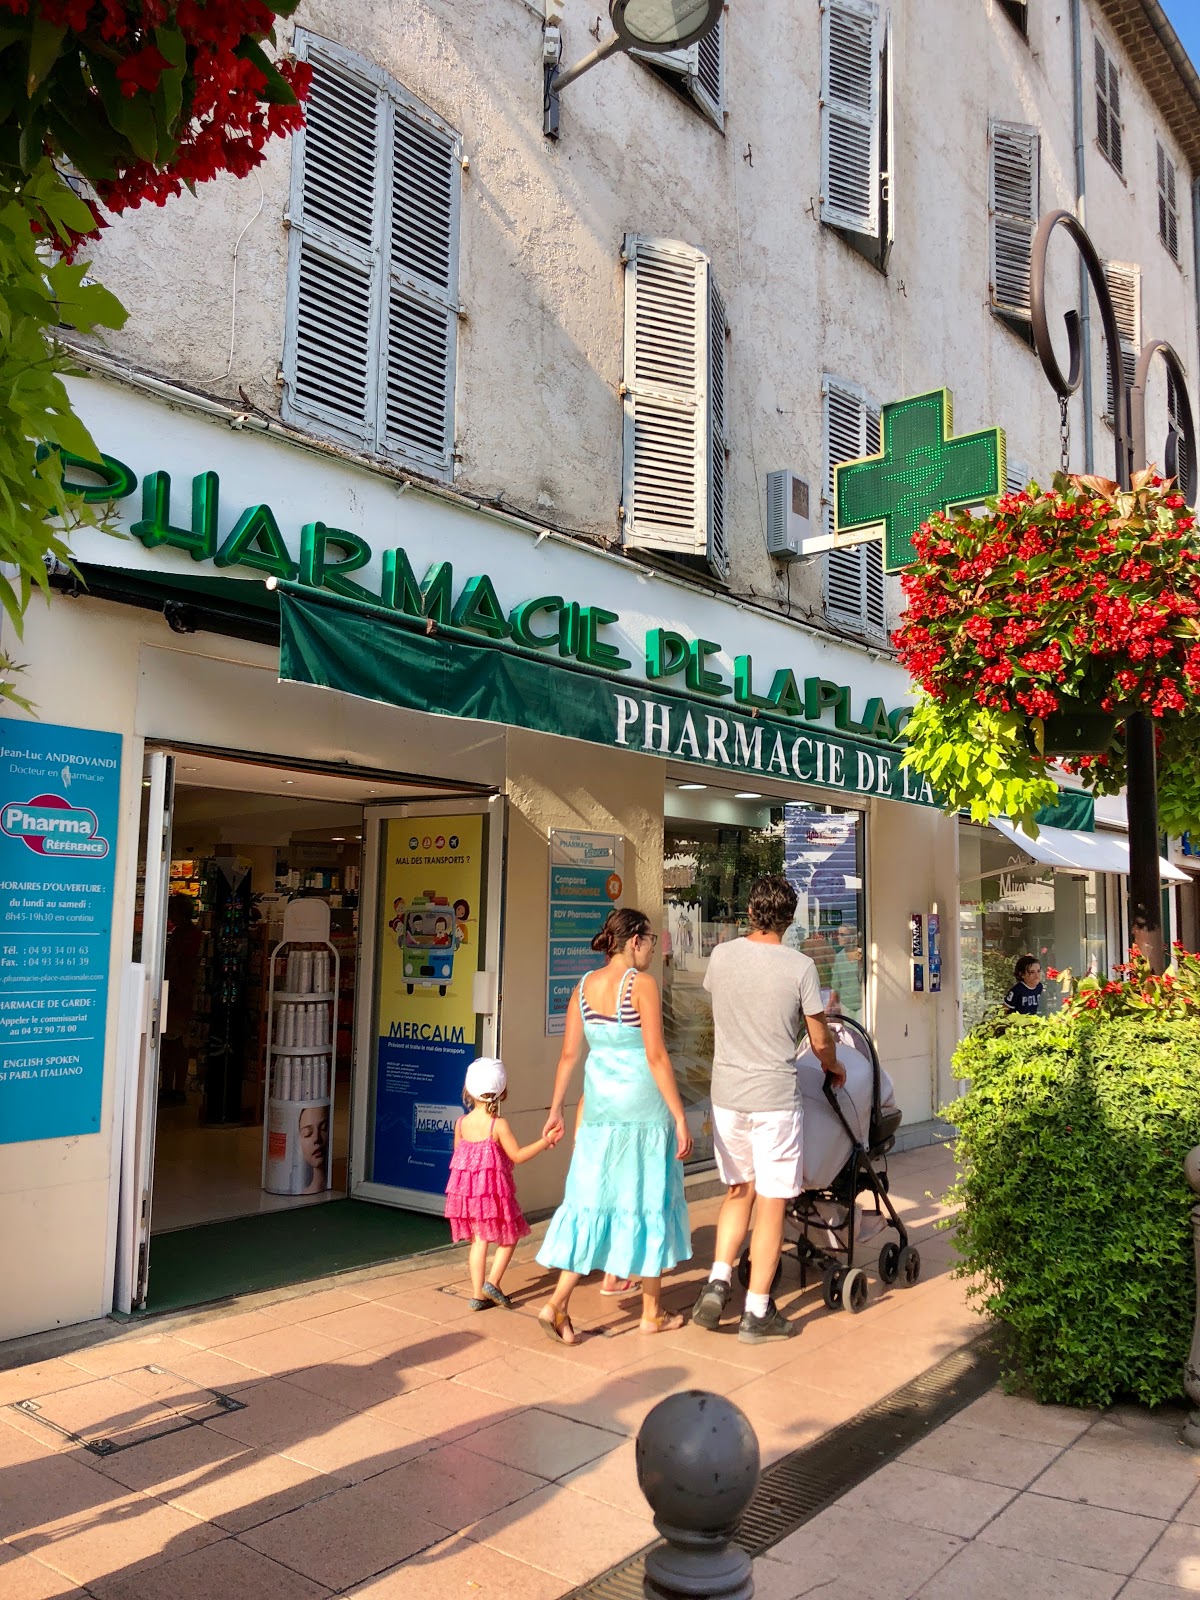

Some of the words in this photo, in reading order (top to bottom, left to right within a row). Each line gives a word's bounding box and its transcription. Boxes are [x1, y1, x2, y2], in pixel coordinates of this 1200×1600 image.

[35, 441, 632, 670] PHARMACIE
[645, 627, 733, 696] DE
[734, 654, 805, 716] LA
[613, 693, 845, 788] PHARMACIE
[855, 750, 893, 795] DE
[901, 764, 935, 803] LA
[0, 746, 43, 761] Jean-Luc
[45, 752, 117, 769] ANDROVANDI
[9, 764, 46, 776] Docteur
[47, 770, 58, 778] en
[6, 808, 92, 834] Pharma
[46, 839, 103, 853] RÉFÉRENCE
[395, 857, 410, 865] MAL
[411, 856, 423, 865] DES
[424, 855, 464, 864] TRANSPORTS
[555, 875, 587, 885] Comparez
[9, 898, 20, 908] du
[23, 898, 44, 908] lundi
[58, 900, 86, 908] samedi
[5, 912, 54, 921] 8h45-19h30
[66, 914, 94, 922] continu
[911, 920, 921, 955] MANIX
[3, 946, 18, 954] Tél.
[28, 946, 39, 954] 04
[41, 946, 52, 954] 93
[55, 946, 64, 954] 34
[66, 946, 76, 954] 01
[78, 946, 89, 954] 63
[1, 958, 18, 966] Fax.
[28, 958, 39, 966] 04
[41, 957, 52, 966] 93
[55, 957, 64, 966] 34
[66, 957, 76, 965] 61
[79, 957, 89, 965] 39
[553, 986, 570, 995] Carte
[47, 999, 59, 1008] DE
[61, 998, 91, 1008] GARDE
[1022, 993, 1041, 1006] POLO
[0, 1016, 29, 1027] Appeler
[31, 1015, 38, 1024] le
[40, 1013, 88, 1023] commissariat
[9, 1028, 19, 1036] au
[21, 1027, 31, 1035] 04
[33, 1026, 43, 1034] 92
[56, 1025, 66, 1033] 78
[67, 1024, 77, 1032] 00
[389, 1021, 464, 1043] MERCALM
[3, 1057, 43, 1069] ENGLISH
[45, 1055, 80, 1066] SPOKEN
[9, 1070, 38, 1080] PARLA
[40, 1066, 83, 1078] ITALIANO
[417, 1118, 456, 1132] MERCAL
